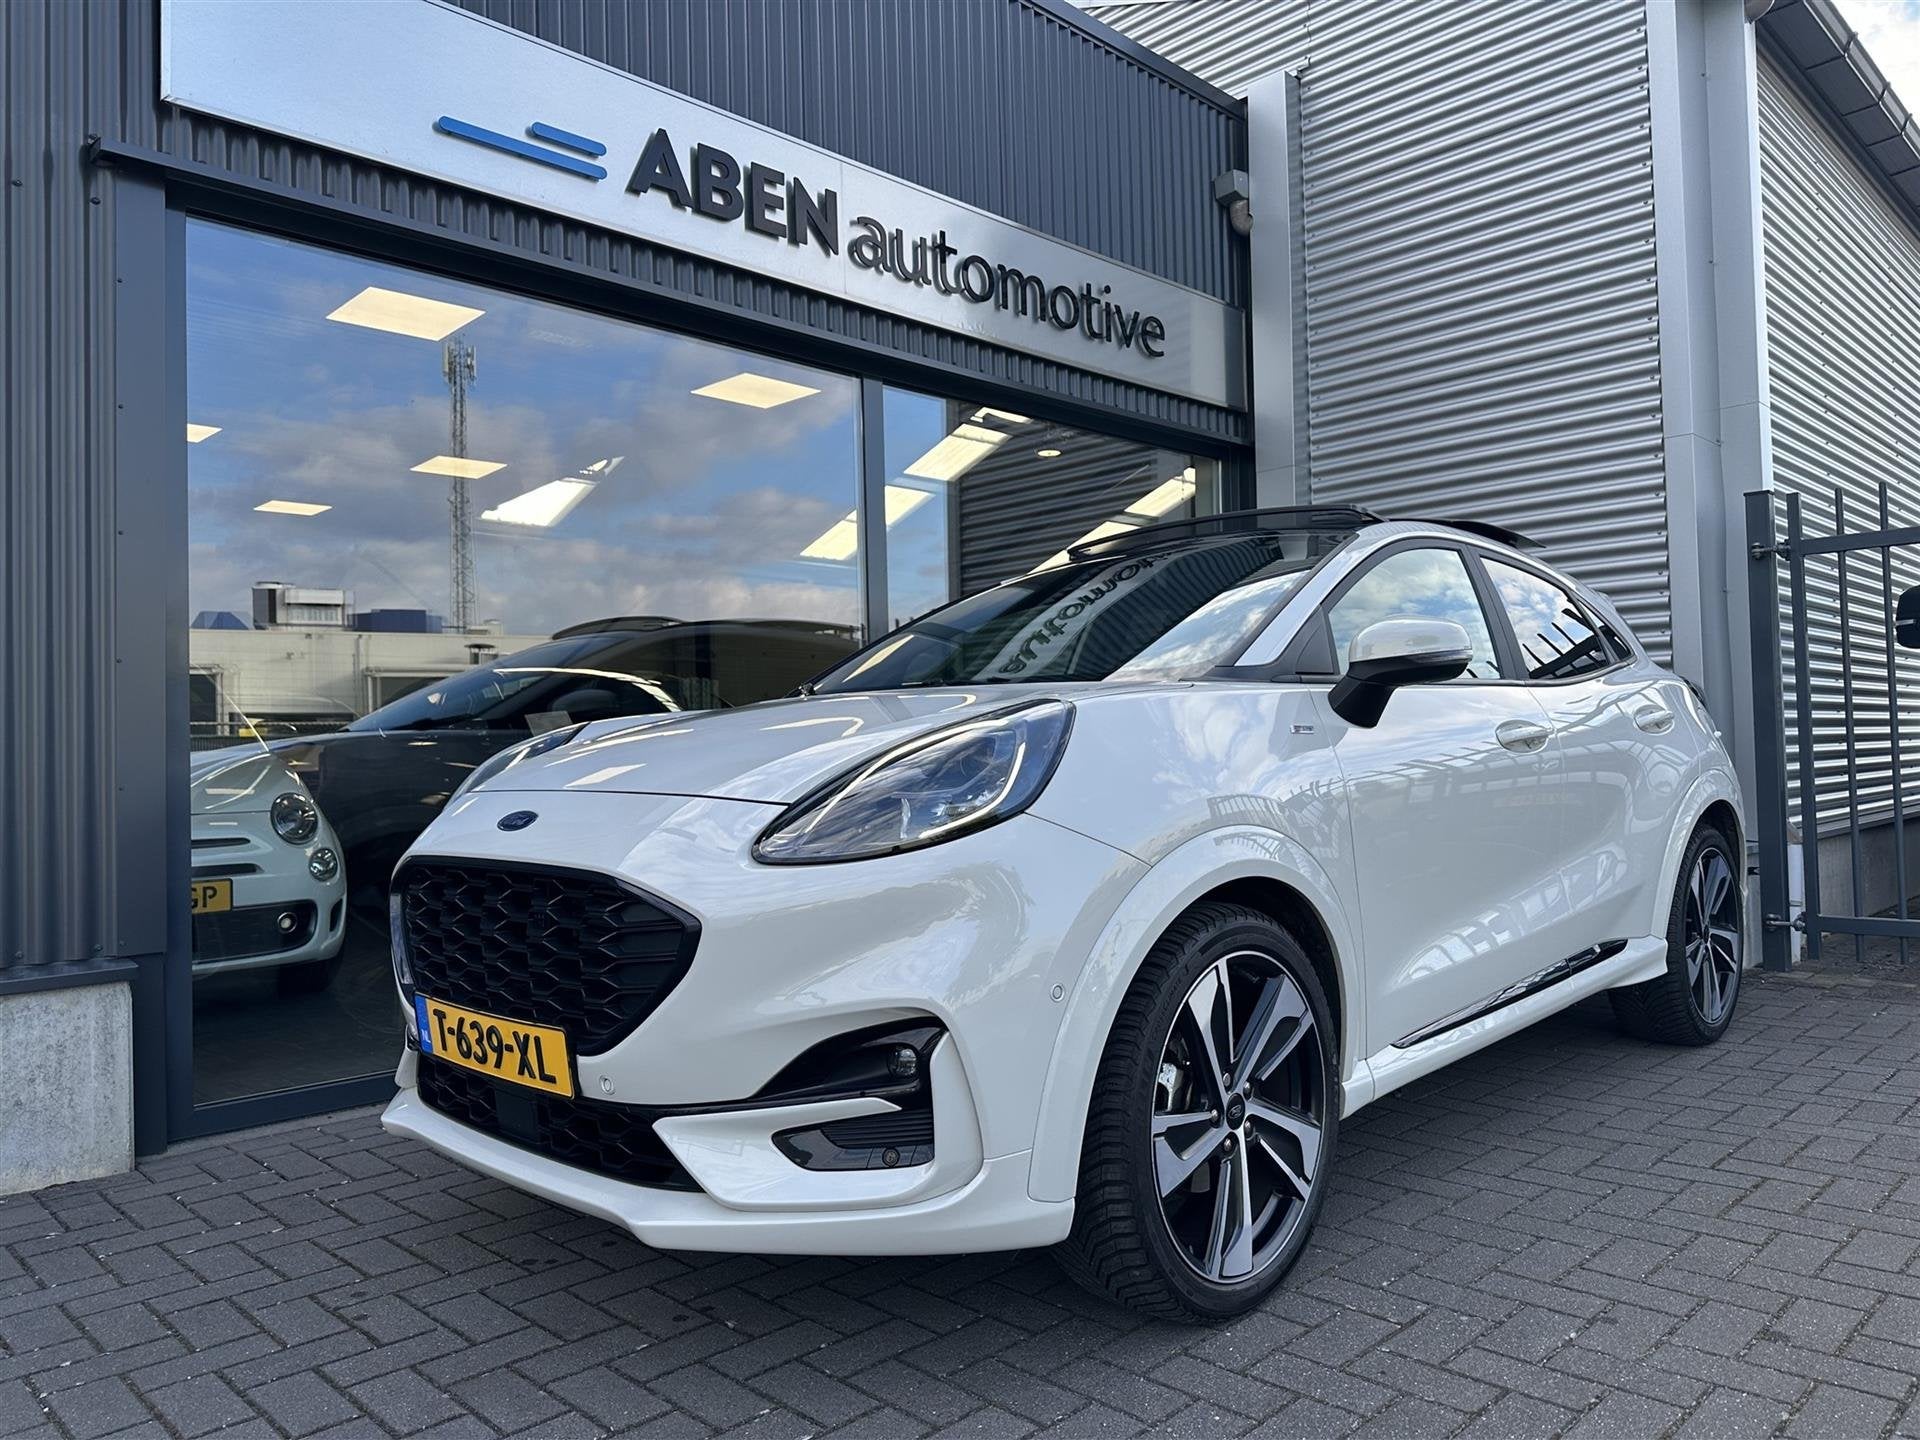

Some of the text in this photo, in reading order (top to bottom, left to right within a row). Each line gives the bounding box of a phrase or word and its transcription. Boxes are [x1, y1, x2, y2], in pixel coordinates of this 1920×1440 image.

[626, 127, 1166, 358] ABEN automotive
[420, 1008, 557, 1084] NL T-639-XL
